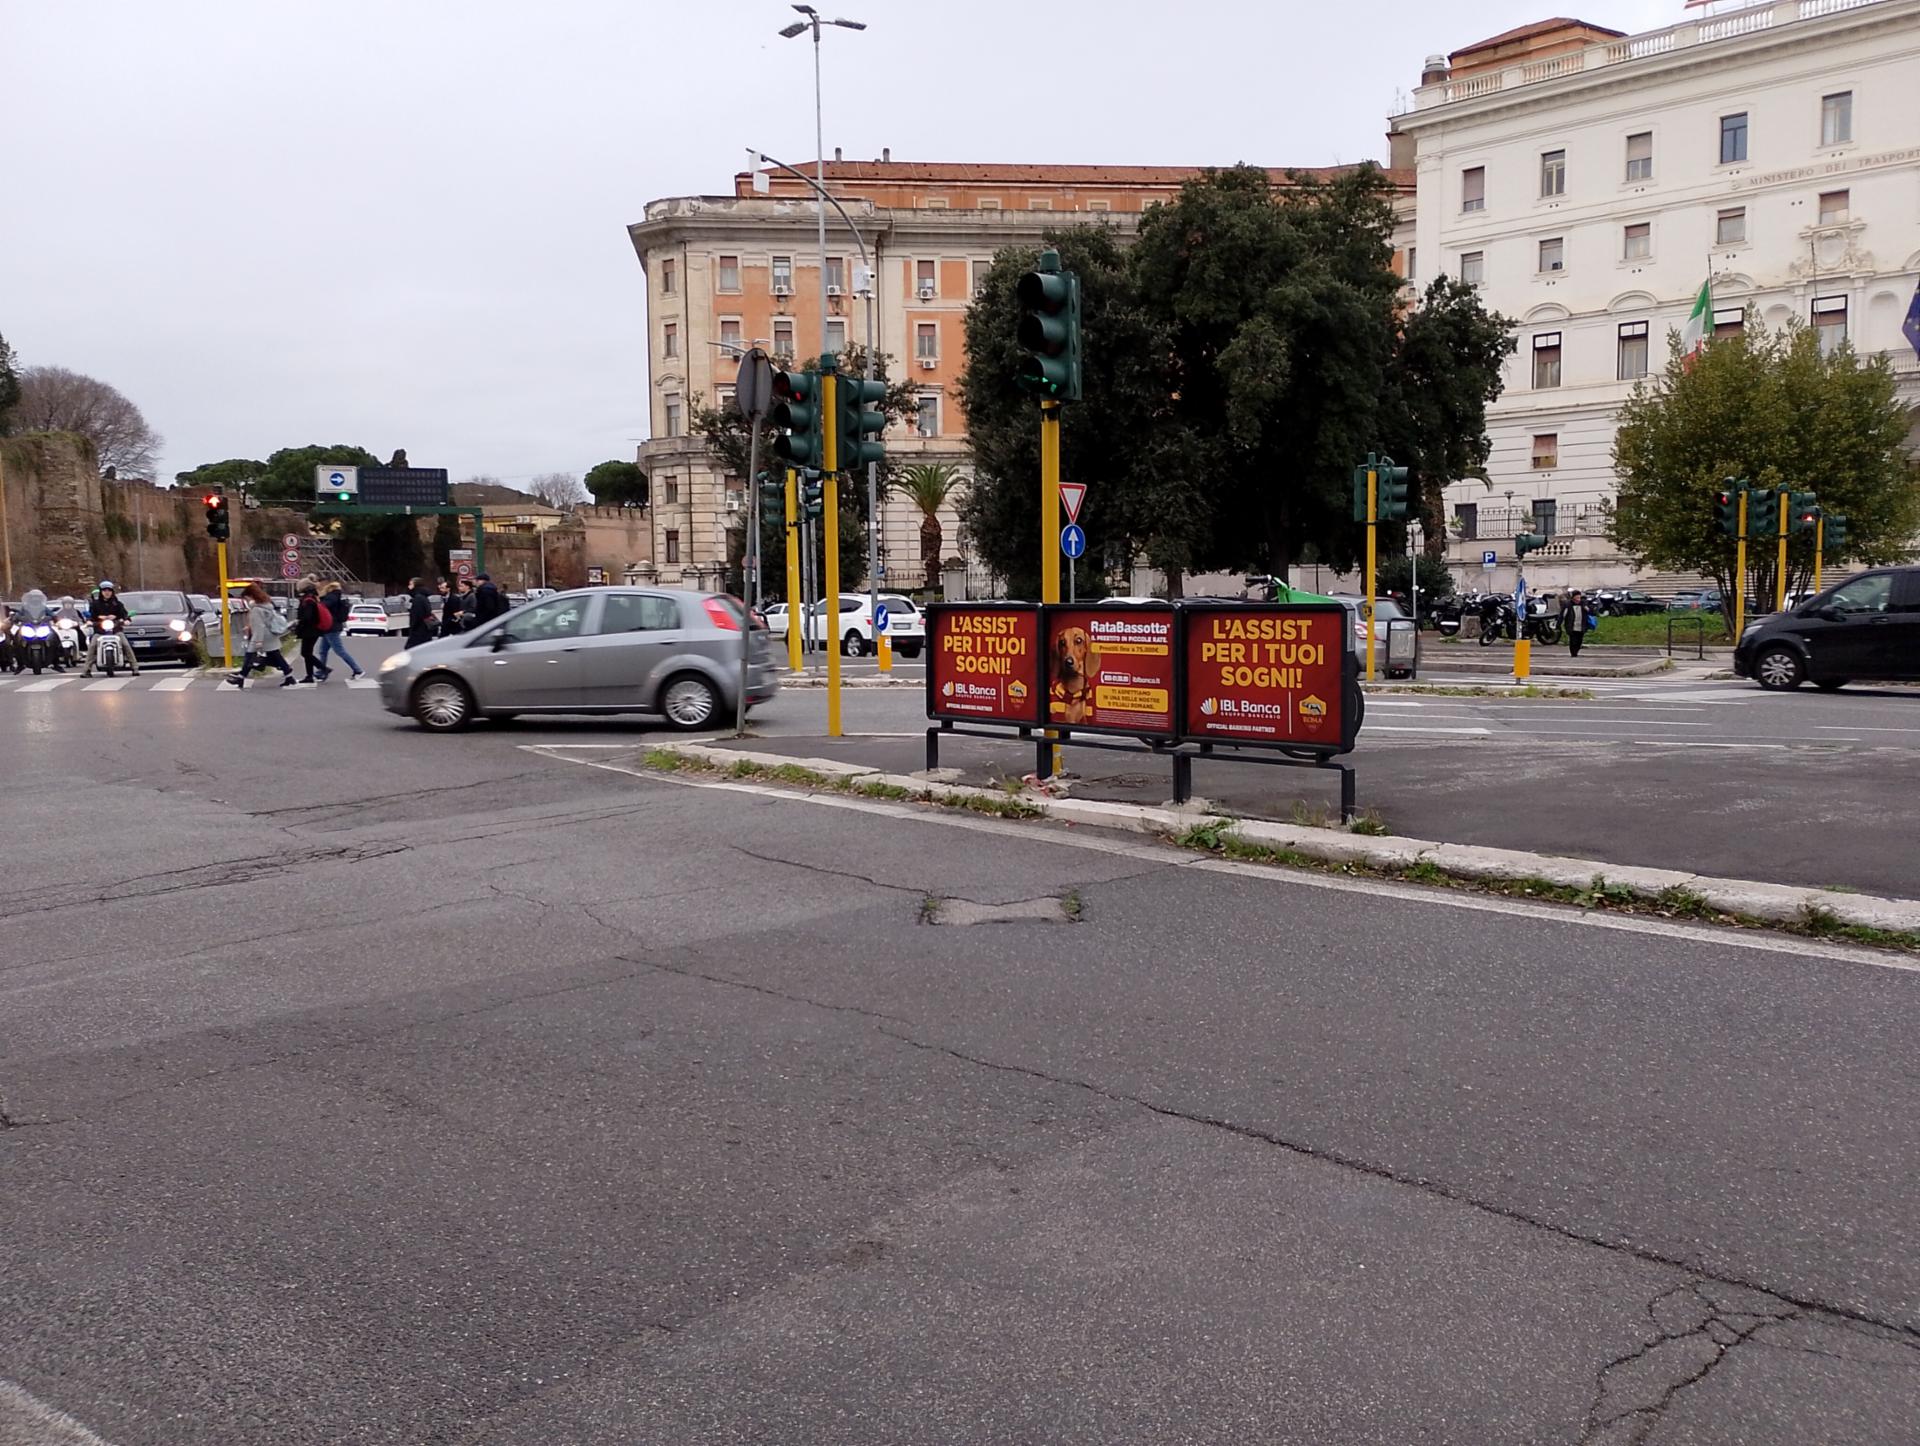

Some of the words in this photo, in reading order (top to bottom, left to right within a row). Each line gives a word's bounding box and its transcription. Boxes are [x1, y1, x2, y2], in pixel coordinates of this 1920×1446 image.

[1750, 168, 1814, 186] MINISTERO
[1825, 163, 1847, 174] DEI
[1485, 552, 1494, 563] P
[951, 616, 1018, 634] L'ASSIST
[1213, 619, 1312, 640] L'ASSIST
[943, 635, 973, 653] PER
[976, 636, 982, 653] I
[985, 637, 1026, 655] TUOI
[1202, 642, 1245, 663] PER
[1252, 643, 1259, 663] I
[1265, 643, 1324, 665] TUOI
[955, 655, 1011, 675] SOGNI!
[1220, 666, 1303, 689] SOGNI!
[955, 683, 968, 694] IBL
[969, 684, 996, 696] Banca
[1220, 700, 1239, 712] IBL
[1241, 700, 1281, 714] Banca
